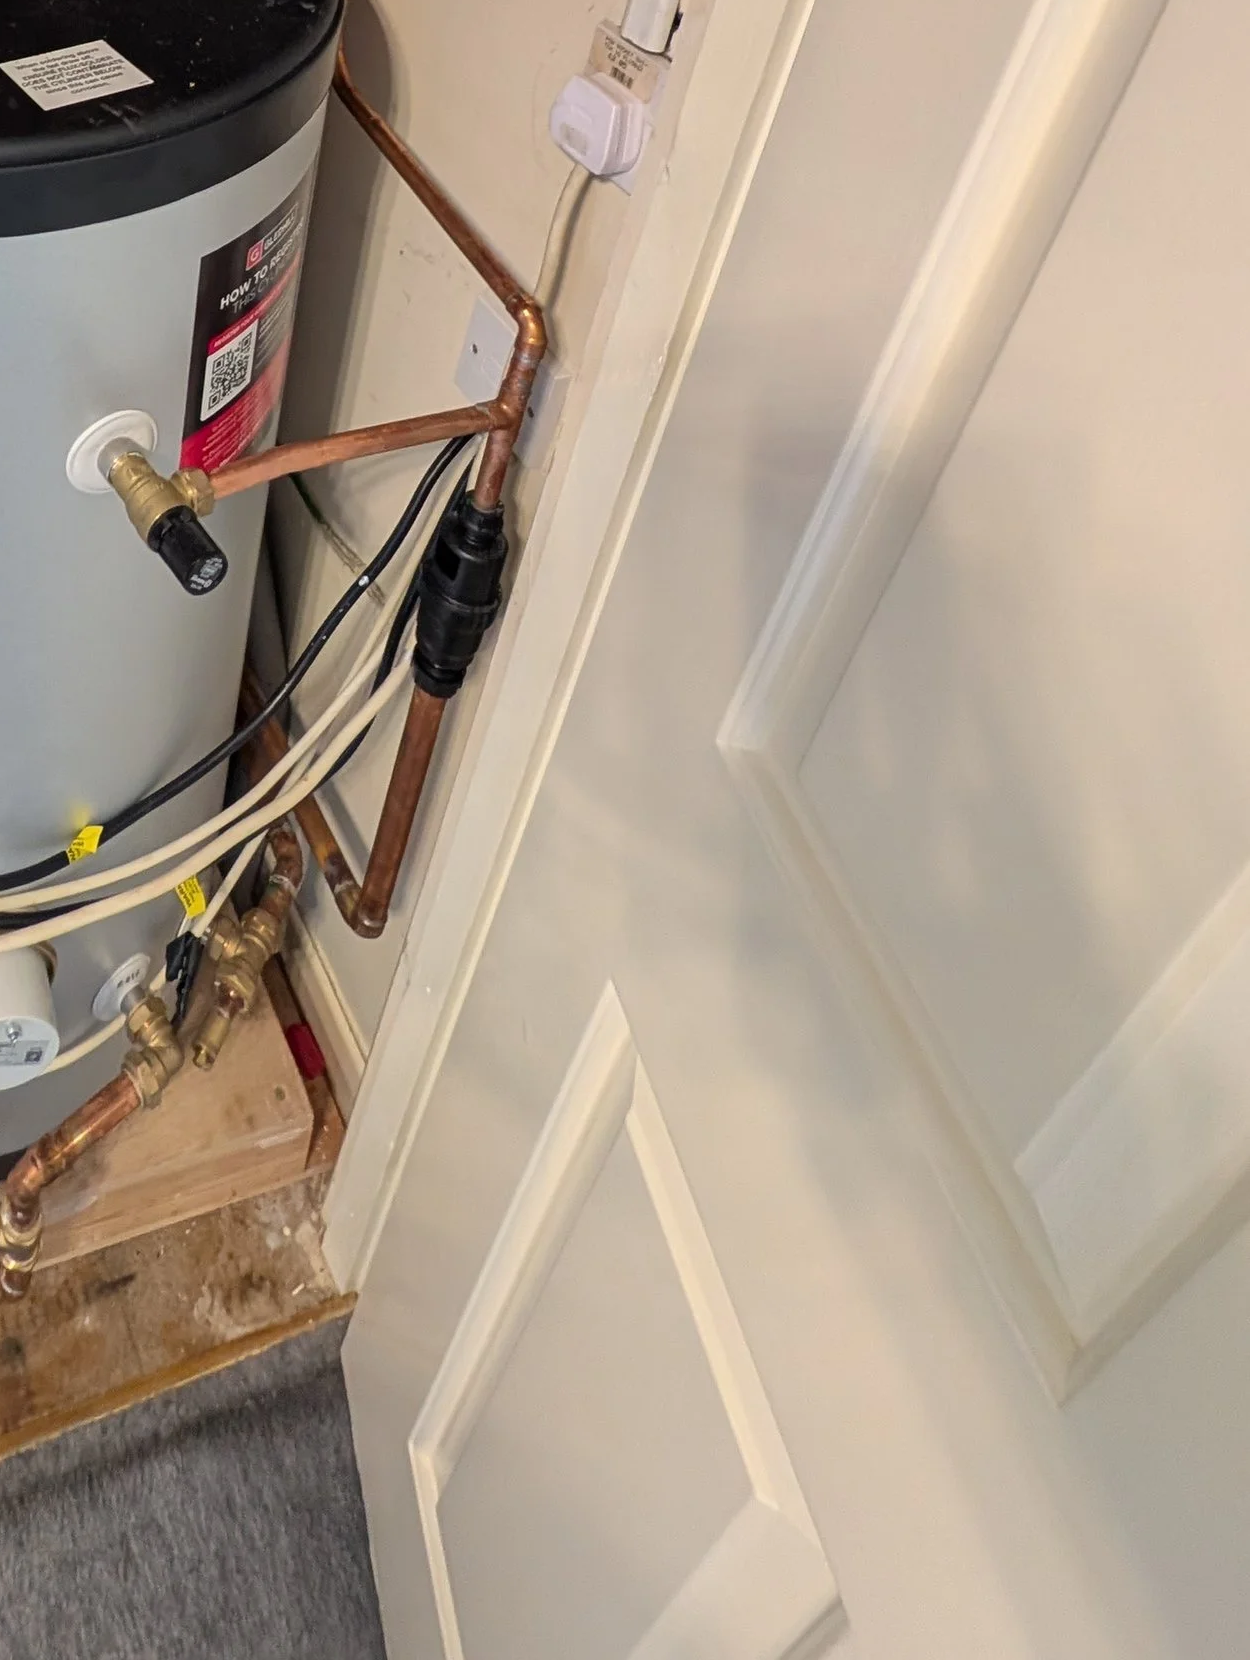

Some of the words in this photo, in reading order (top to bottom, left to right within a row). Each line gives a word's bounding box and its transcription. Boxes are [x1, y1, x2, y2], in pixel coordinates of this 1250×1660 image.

[251, 246, 260, 262] G
[219, 278, 252, 311] HOW
[254, 264, 269, 285] TO
